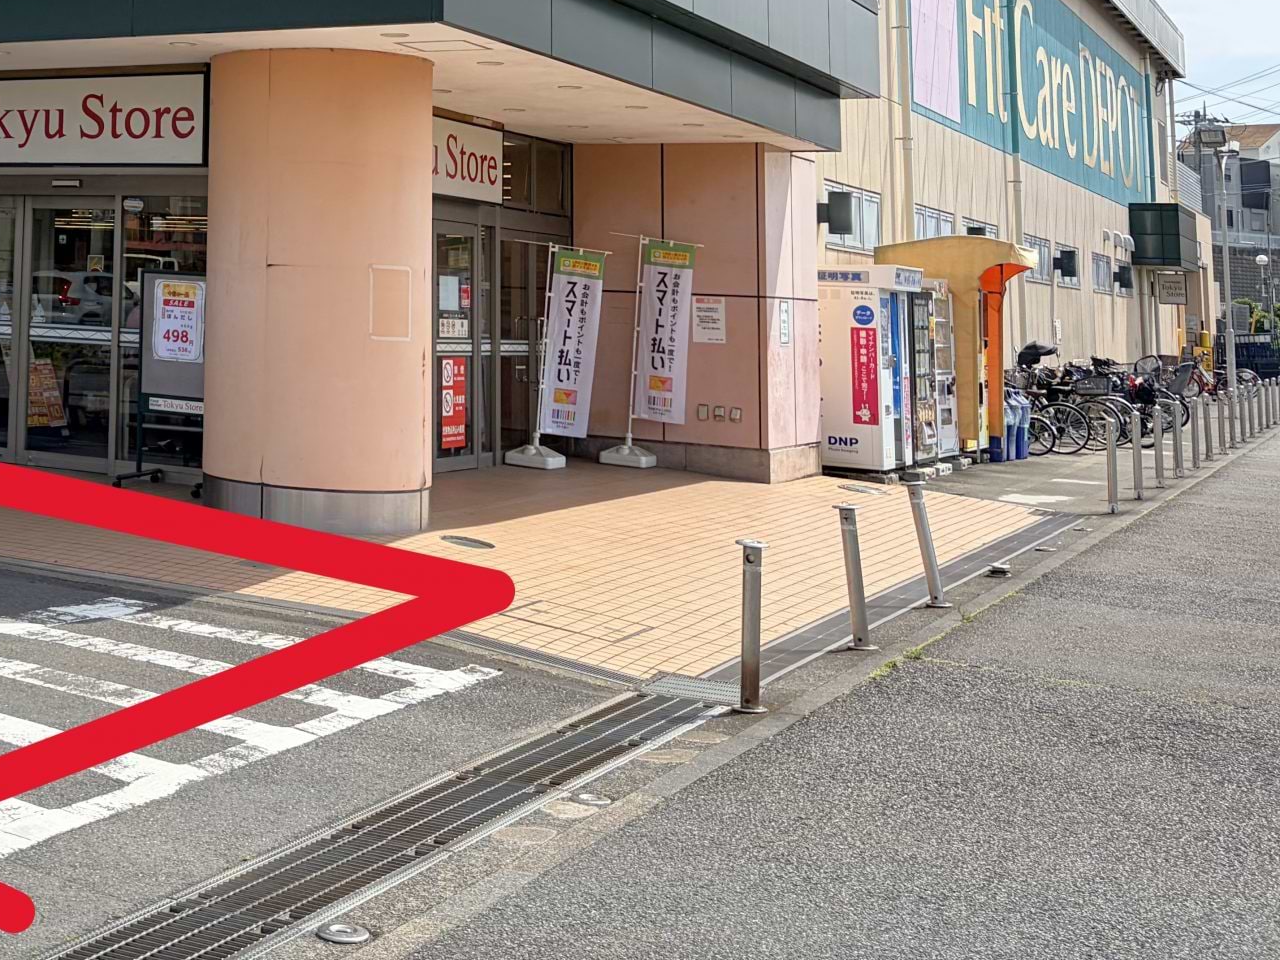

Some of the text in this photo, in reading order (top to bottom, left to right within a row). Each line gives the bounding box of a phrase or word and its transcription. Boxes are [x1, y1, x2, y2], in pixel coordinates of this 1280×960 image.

[79, 93, 196, 140] Store
[1079, 41, 1142, 192] DEPOT
[445, 134, 498, 186] Store
[557, 281, 578, 383] スマート払い
[651, 271, 669, 371] スマート払い
[828, 436, 859, 447] DNP
